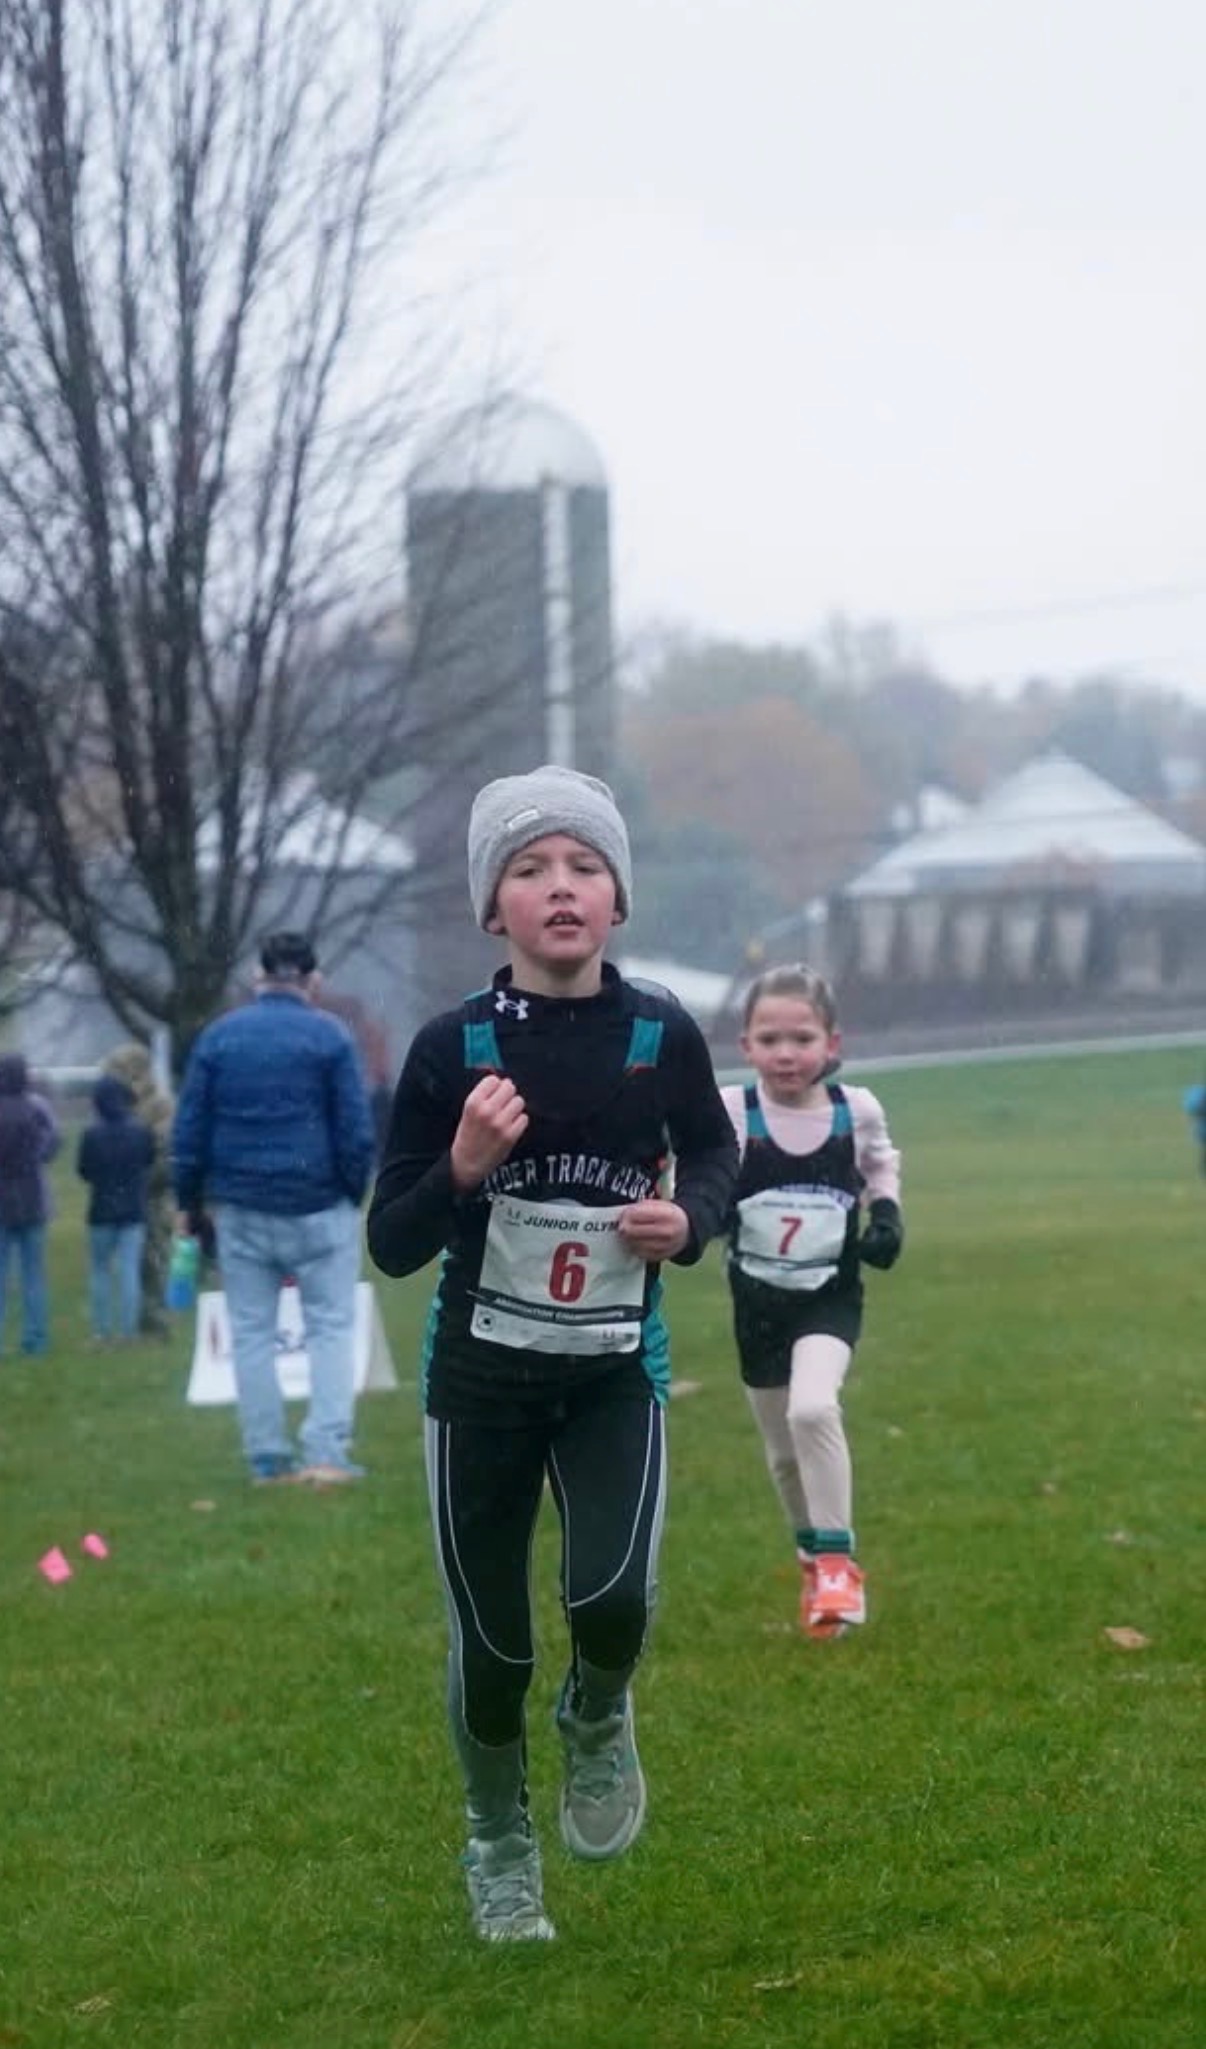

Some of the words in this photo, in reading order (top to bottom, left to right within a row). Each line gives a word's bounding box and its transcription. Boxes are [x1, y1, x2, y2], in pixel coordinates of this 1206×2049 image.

[546, 1153, 611, 1188] TRACK
[523, 1215, 580, 1231] JUNIOR
[583, 1219, 620, 1232] OLYM
[779, 1216, 803, 1256] 7
[548, 1241, 590, 1303] 6
